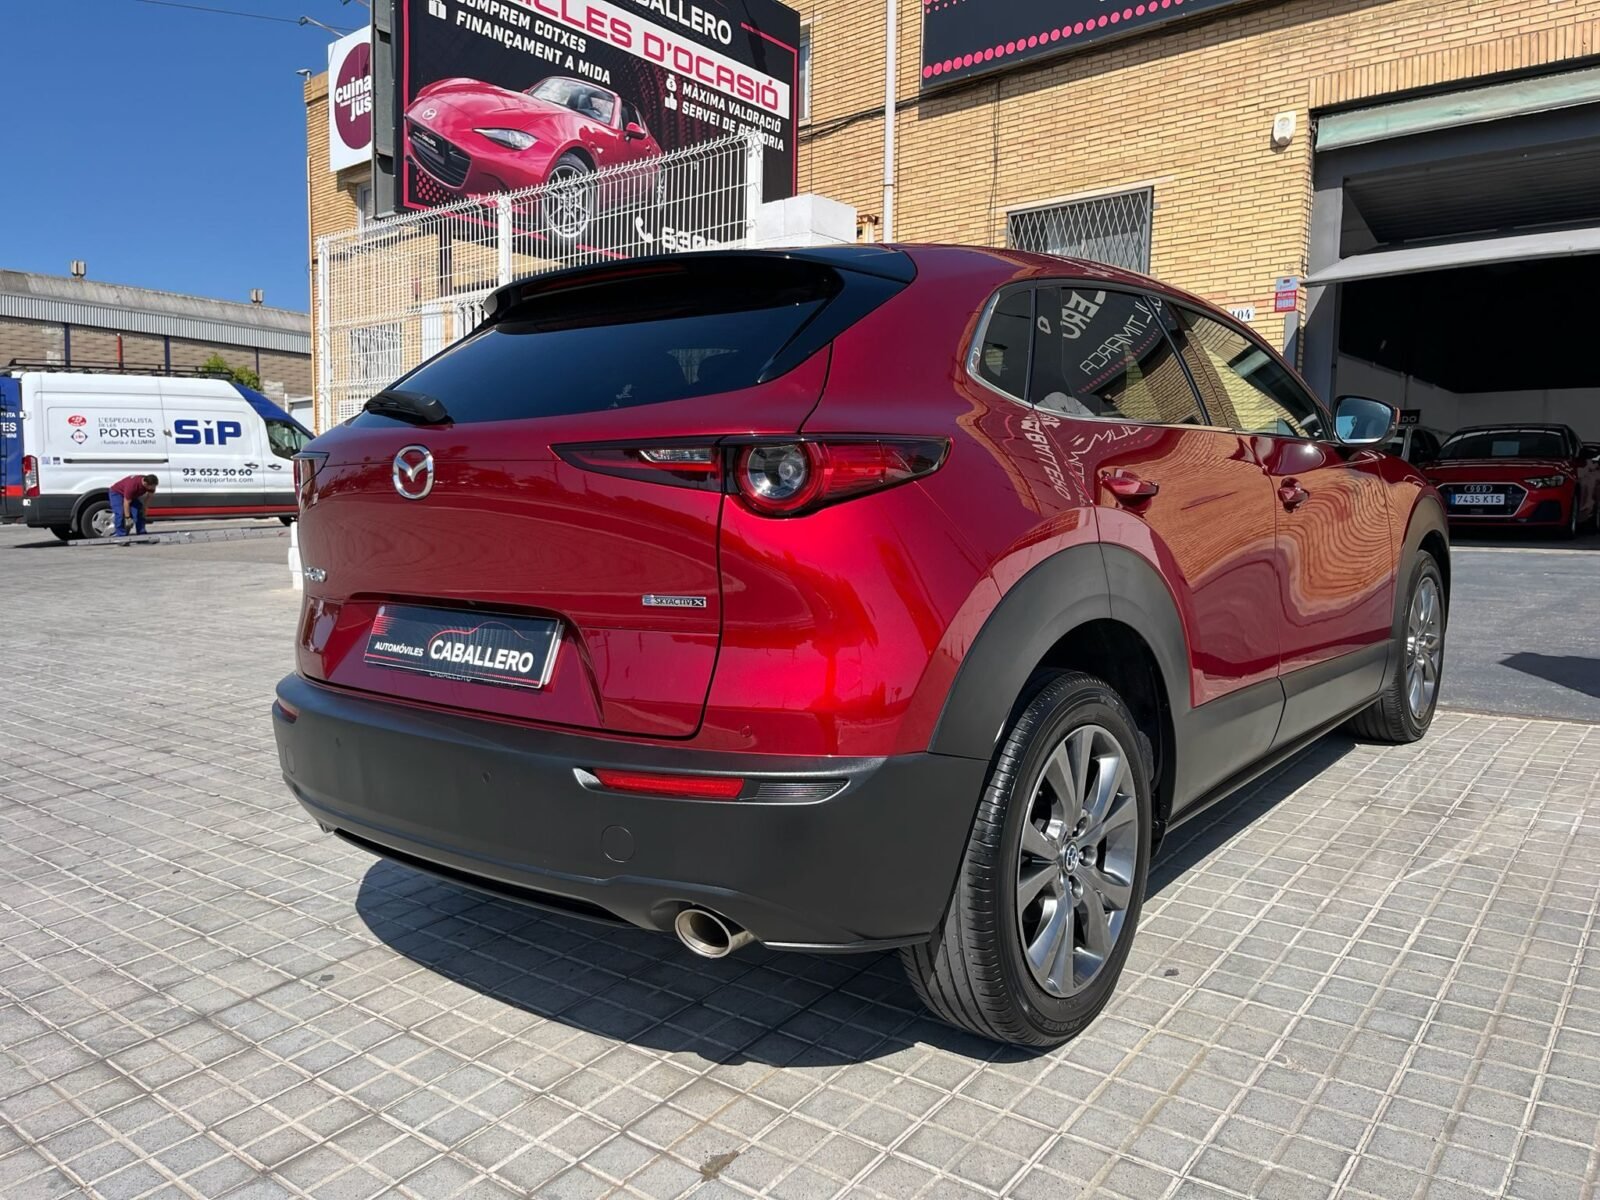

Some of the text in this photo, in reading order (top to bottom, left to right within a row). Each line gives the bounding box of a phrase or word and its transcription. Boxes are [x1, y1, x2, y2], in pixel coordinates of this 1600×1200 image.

[535, 20, 587, 53] COTXES
[632, 0, 732, 45] ALLERO
[456, 10, 611, 84] FINANÇAMENT A MIDA
[643, 31, 778, 111] D'OCASIÓ
[335, 74, 372, 104] cuina
[350, 96, 372, 122] jus
[682, 82, 782, 133] MÀXIMA VALORACIÓ
[682, 101, 784, 152] SERVEI DE GEORIA
[99, 428, 156, 438] PORTES
[182, 468, 253, 476] 93 652 50 60
[1457, 496, 1501, 504] 7435 KTS
[374, 639, 534, 673] AUTOMÓVILES CABALLERO
